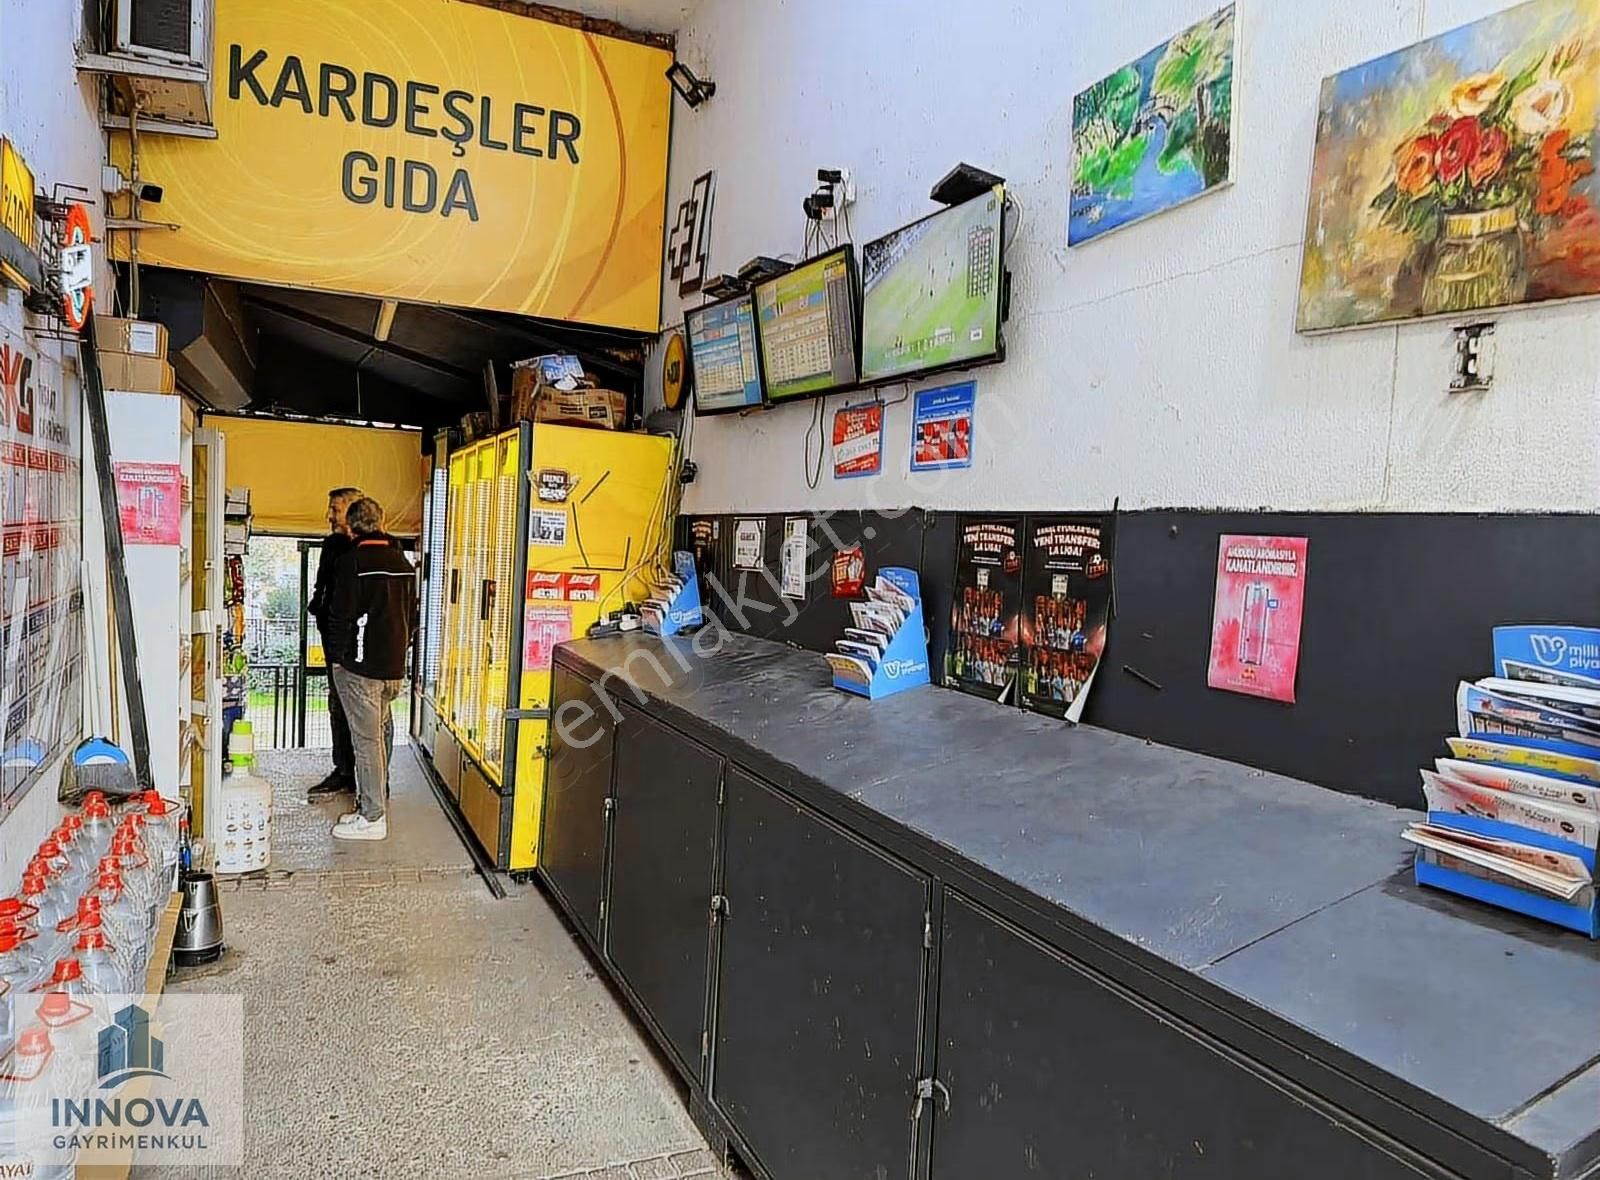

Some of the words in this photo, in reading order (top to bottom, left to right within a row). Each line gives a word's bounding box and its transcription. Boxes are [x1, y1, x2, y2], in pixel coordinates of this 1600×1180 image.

[229, 44, 581, 164] KARDEŞLER
[342, 151, 479, 222] GIDA
[1033, 532, 1053, 548] YENİ
[1048, 545, 1059, 556] LA
[1569, 644, 1599, 658] milli
